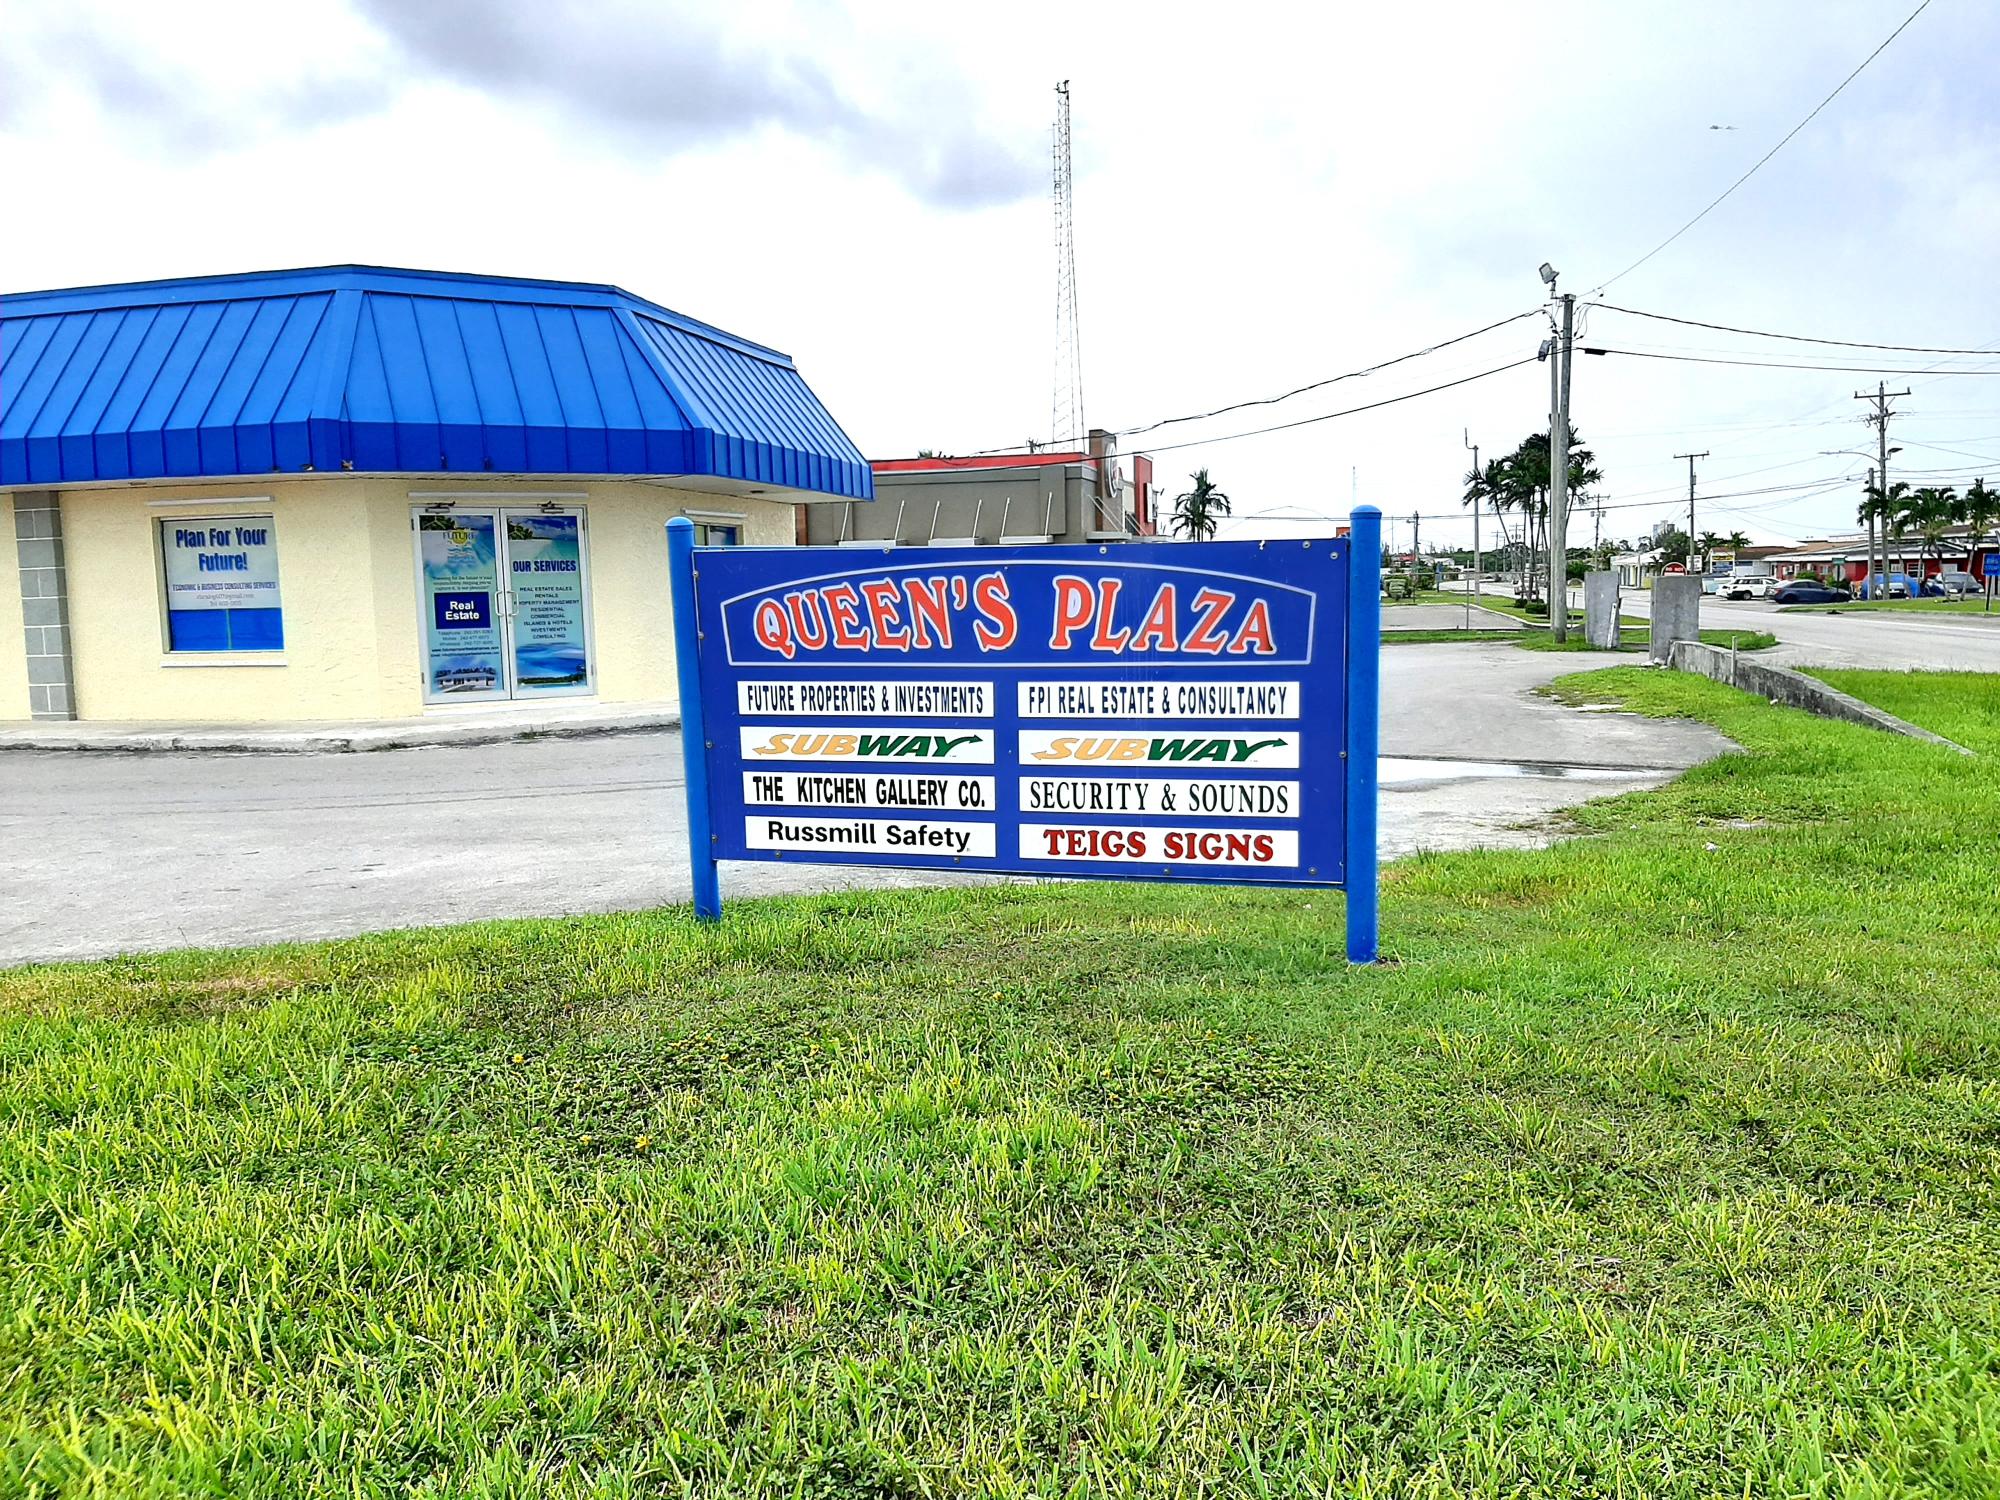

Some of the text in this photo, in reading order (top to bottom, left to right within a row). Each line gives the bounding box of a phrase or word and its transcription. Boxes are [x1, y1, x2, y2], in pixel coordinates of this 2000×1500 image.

[175, 526, 267, 548] Plan For Your
[198, 552, 248, 571] Future!
[512, 559, 577, 573] OUR SERVICES
[445, 611, 480, 620] Estate
[449, 601, 475, 610] Real
[753, 571, 1278, 660] QUEEN'S PLAZA
[747, 685, 984, 713] FUTURE PROPERTIES & INVESTMENTS
[1028, 686, 1287, 714] FPI REAL ESTATE & CONSULTANCY
[752, 734, 984, 757] SUBWAY
[1030, 738, 1289, 762] SUBWAY
[752, 776, 986, 807] THE KITCHEN GALLERY CO.
[1030, 781, 1289, 814] SECURITY & SOUNDS
[768, 821, 971, 853] Russmill Safety
[1043, 829, 1274, 862] TEIGS SIGNS
